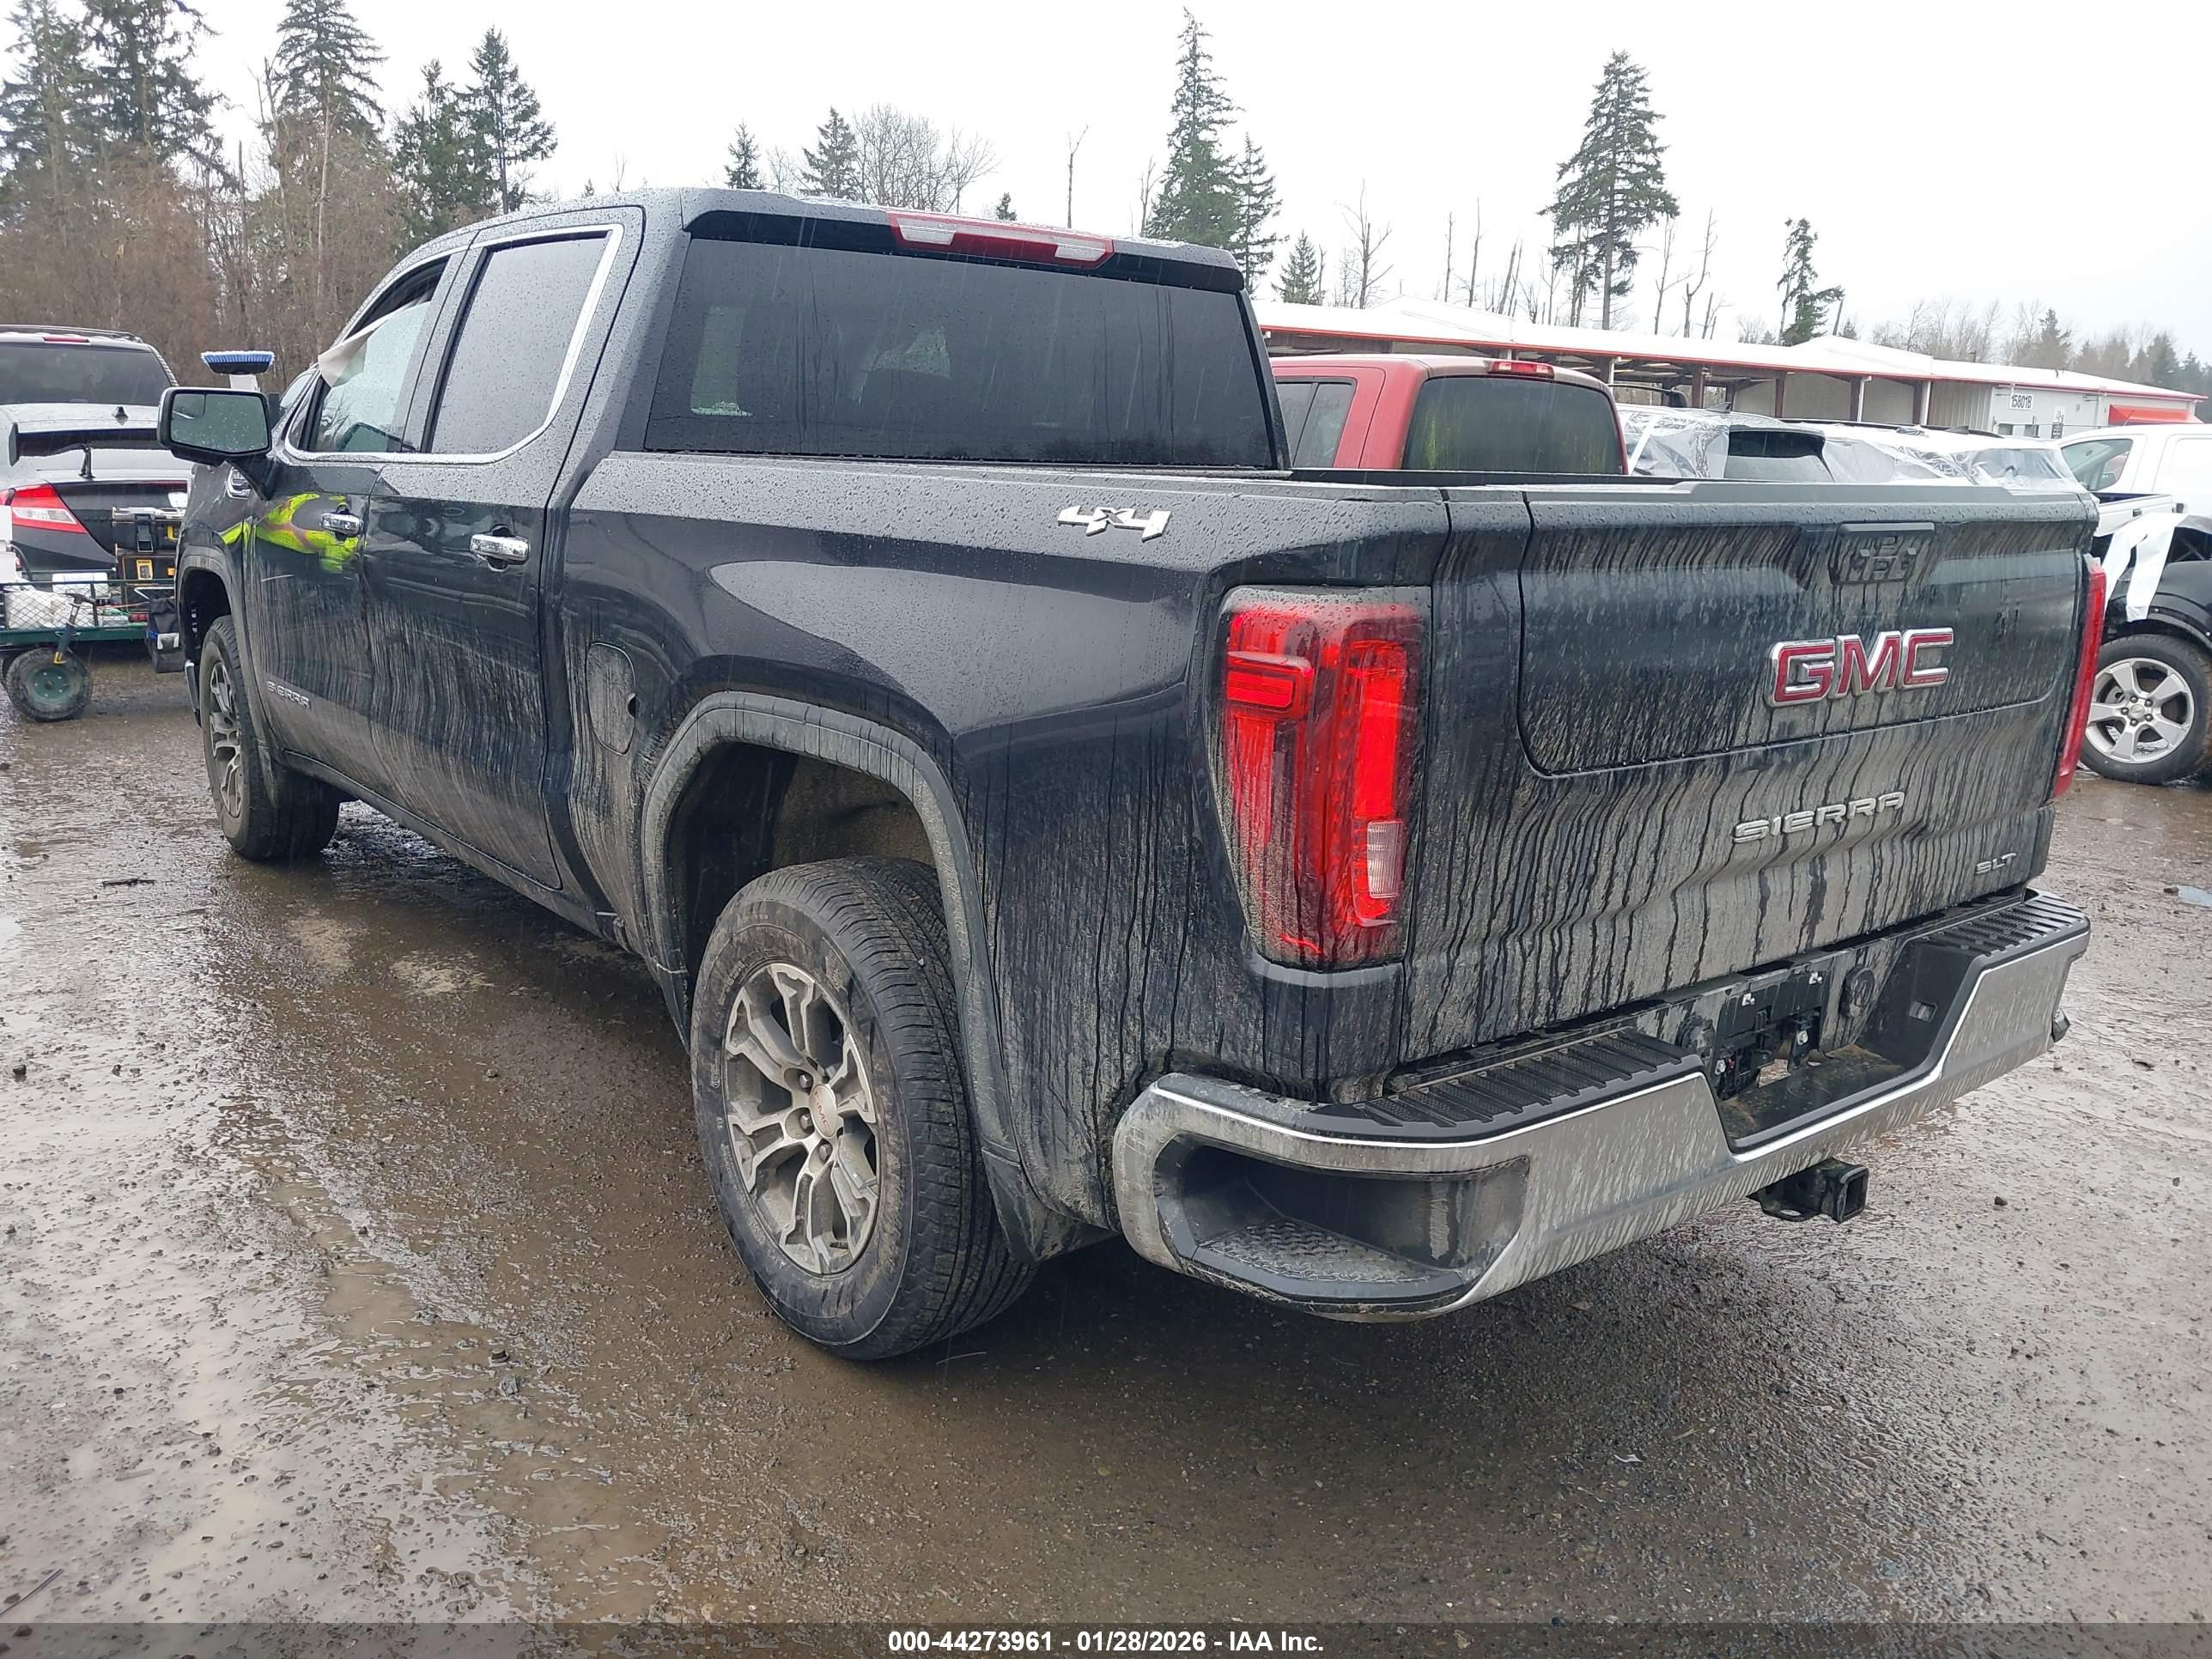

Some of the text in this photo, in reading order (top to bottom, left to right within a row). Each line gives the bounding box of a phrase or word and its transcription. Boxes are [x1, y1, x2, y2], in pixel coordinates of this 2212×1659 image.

[1765, 628, 1954, 708] GMC
[1733, 791, 1905, 843] SIERRA
[1975, 853, 2017, 875] SLT
[813, 1090, 831, 1133] GMC
